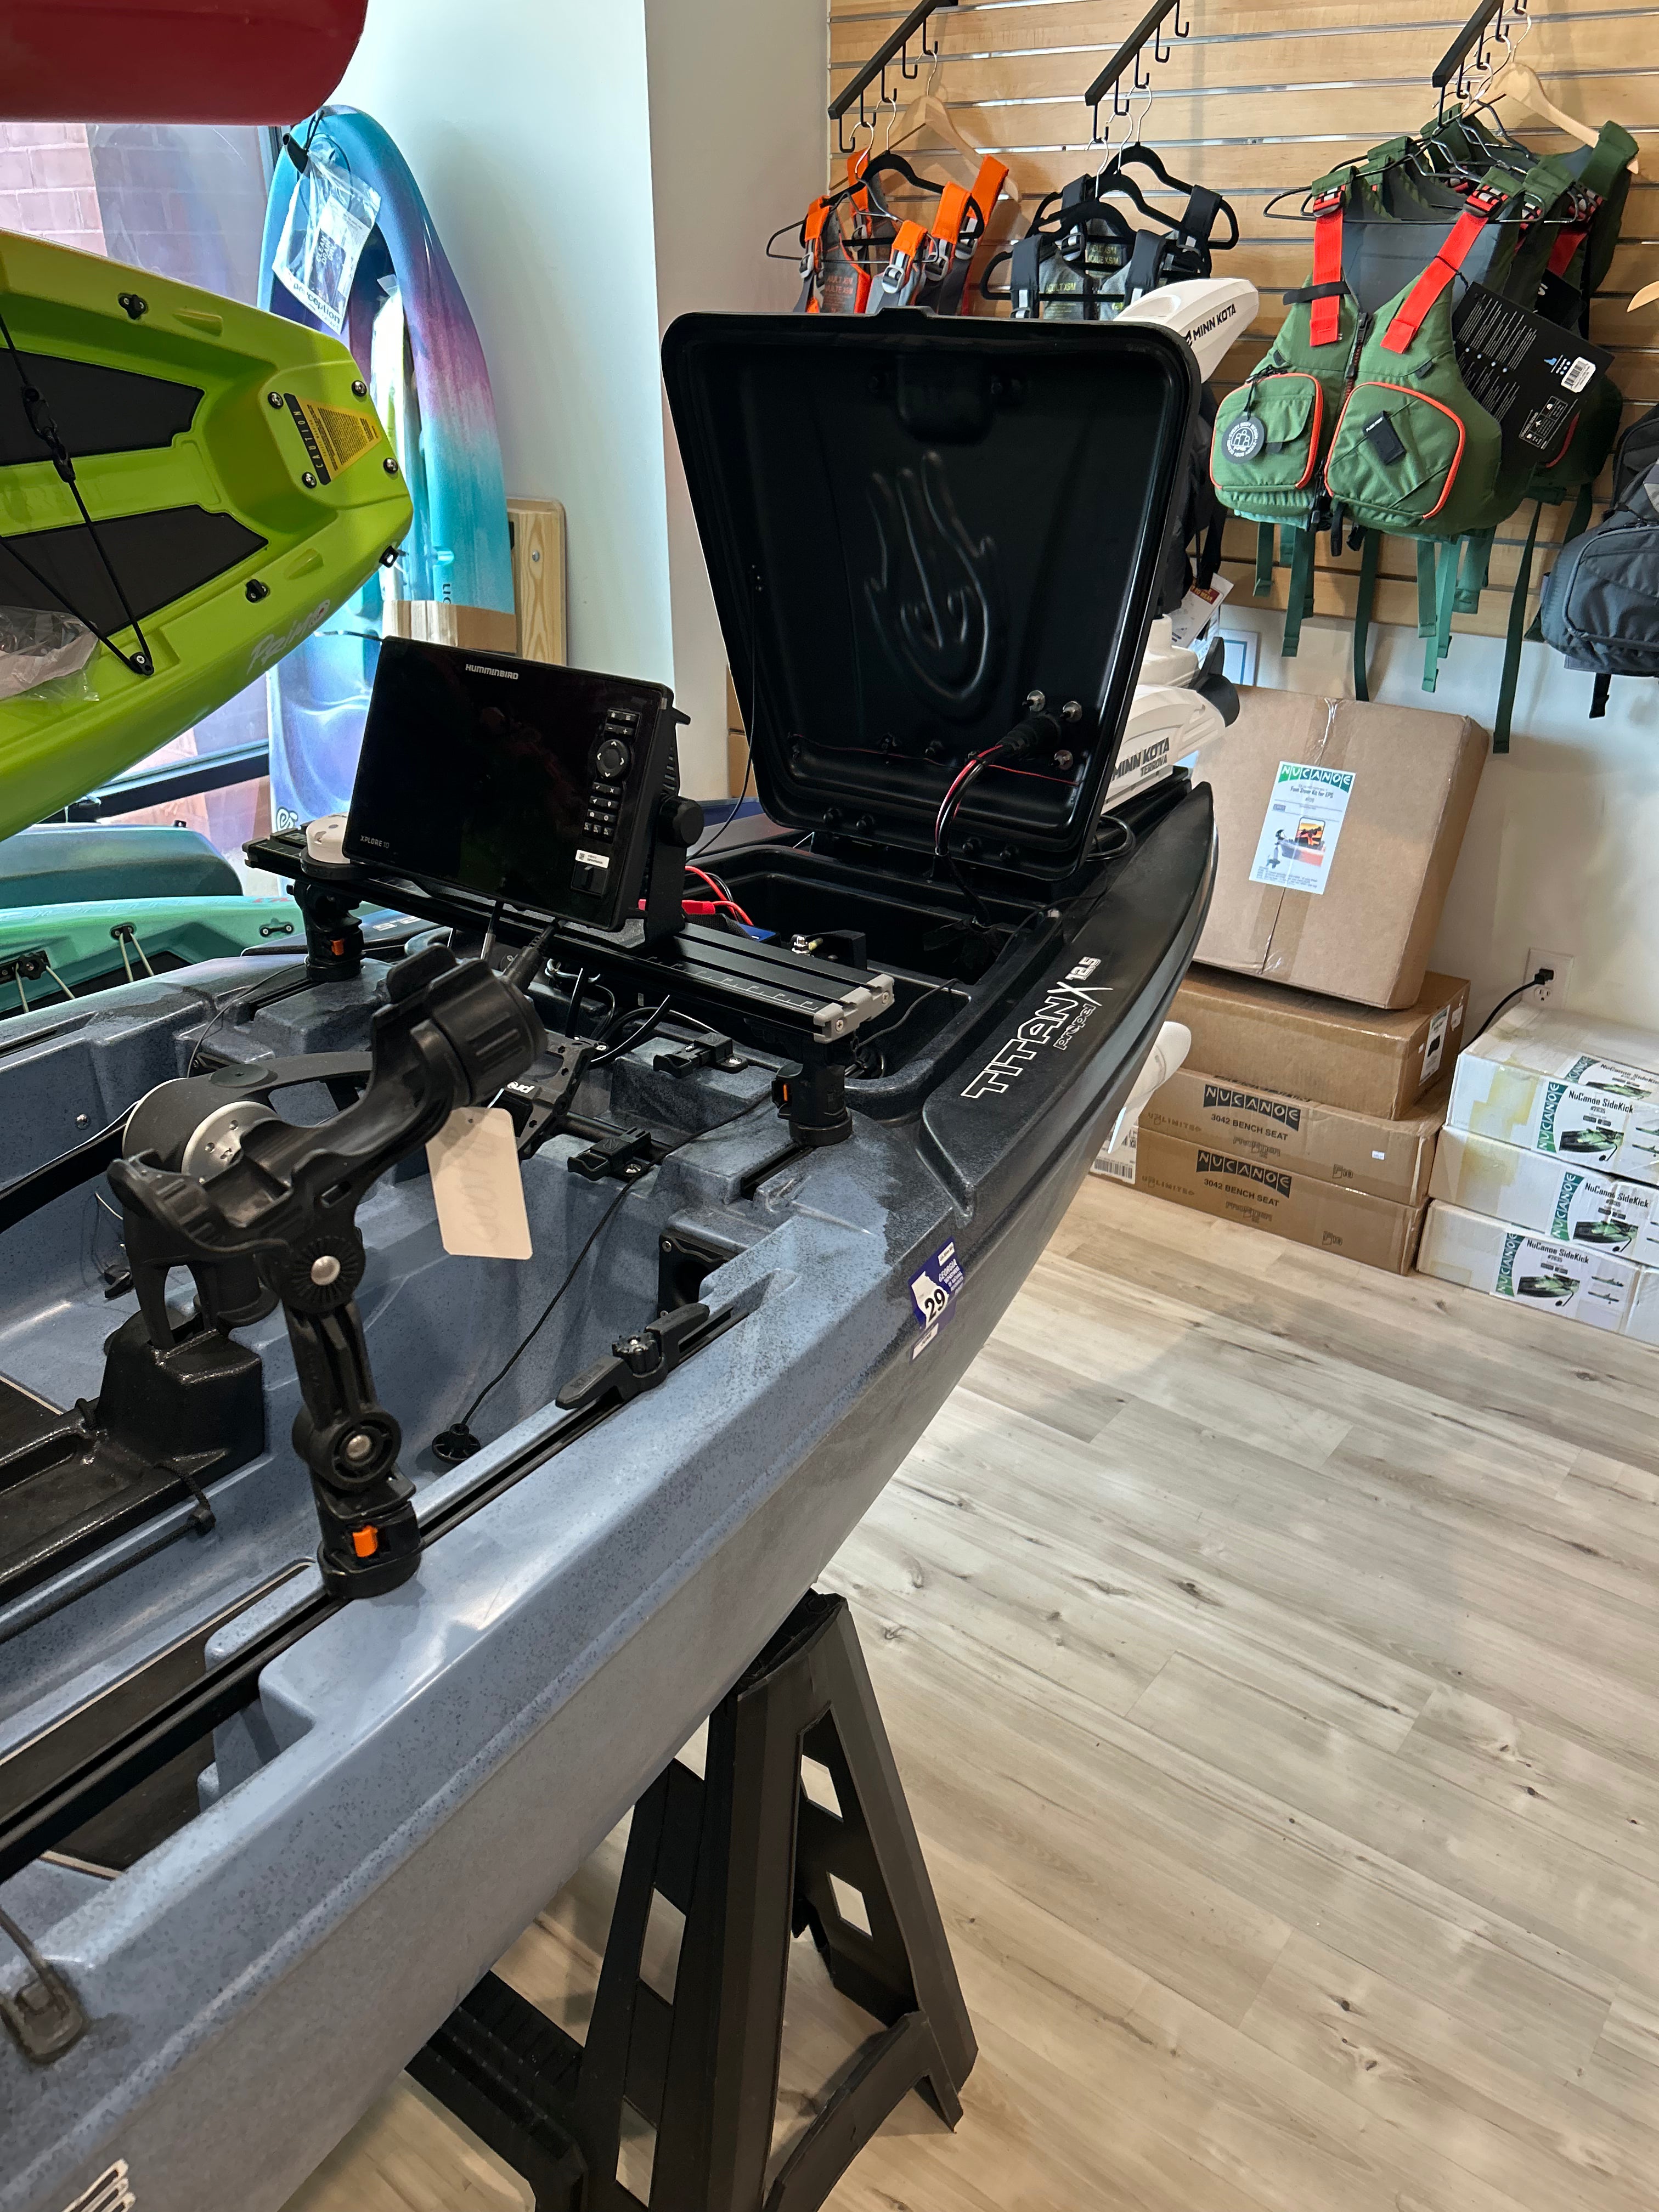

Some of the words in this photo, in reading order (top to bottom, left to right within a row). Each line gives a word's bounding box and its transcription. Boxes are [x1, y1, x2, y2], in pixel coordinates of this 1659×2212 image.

[1193, 317, 1216, 341] MINN
[1216, 303, 1236, 325] KOTA
[293, 411, 324, 468] CAUTION
[465, 664, 518, 680] HUMMINBIRD
[1111, 752, 1142, 782] MINN
[1143, 737, 1169, 764] KOTA
[1141, 754, 1167, 777] TERROVA
[1280, 765, 1352, 788] NUCANOE
[360, 835, 382, 847] XPLORE
[1064, 956, 1102, 980] 12.5
[1053, 1003, 1097, 1051] propel
[1204, 1086, 1300, 1125] NUCANOE
[1569, 1090, 1600, 1105] NuCanoe
[1602, 1098, 1634, 1114] SideKick
[1211, 1113, 1230, 1125] 3042
[1233, 1120, 1263, 1134] BENCH
[1265, 1128, 1288, 1141] SEAT
[1538, 1082, 1563, 1152] NUCANOE
[1198, 1152, 1290, 1192] NUCANOE
[1204, 1178, 1223, 1190] 3042
[1225, 1185, 1255, 1200] BENCH
[1257, 1194, 1280, 1206] SEAT
[1551, 1173, 1578, 1239] NUCANOE
[1585, 1182, 1616, 1198] NuCanoe
[1617, 1192, 1649, 1208] SideKick
[1496, 1233, 1520, 1295] NUCANOE
[1527, 1239, 1558, 1254] NuCanoe
[1559, 1249, 1589, 1264] SideKick
[938, 1259, 958, 1283] GEORGIA
[924, 1289, 945, 1322] 29
